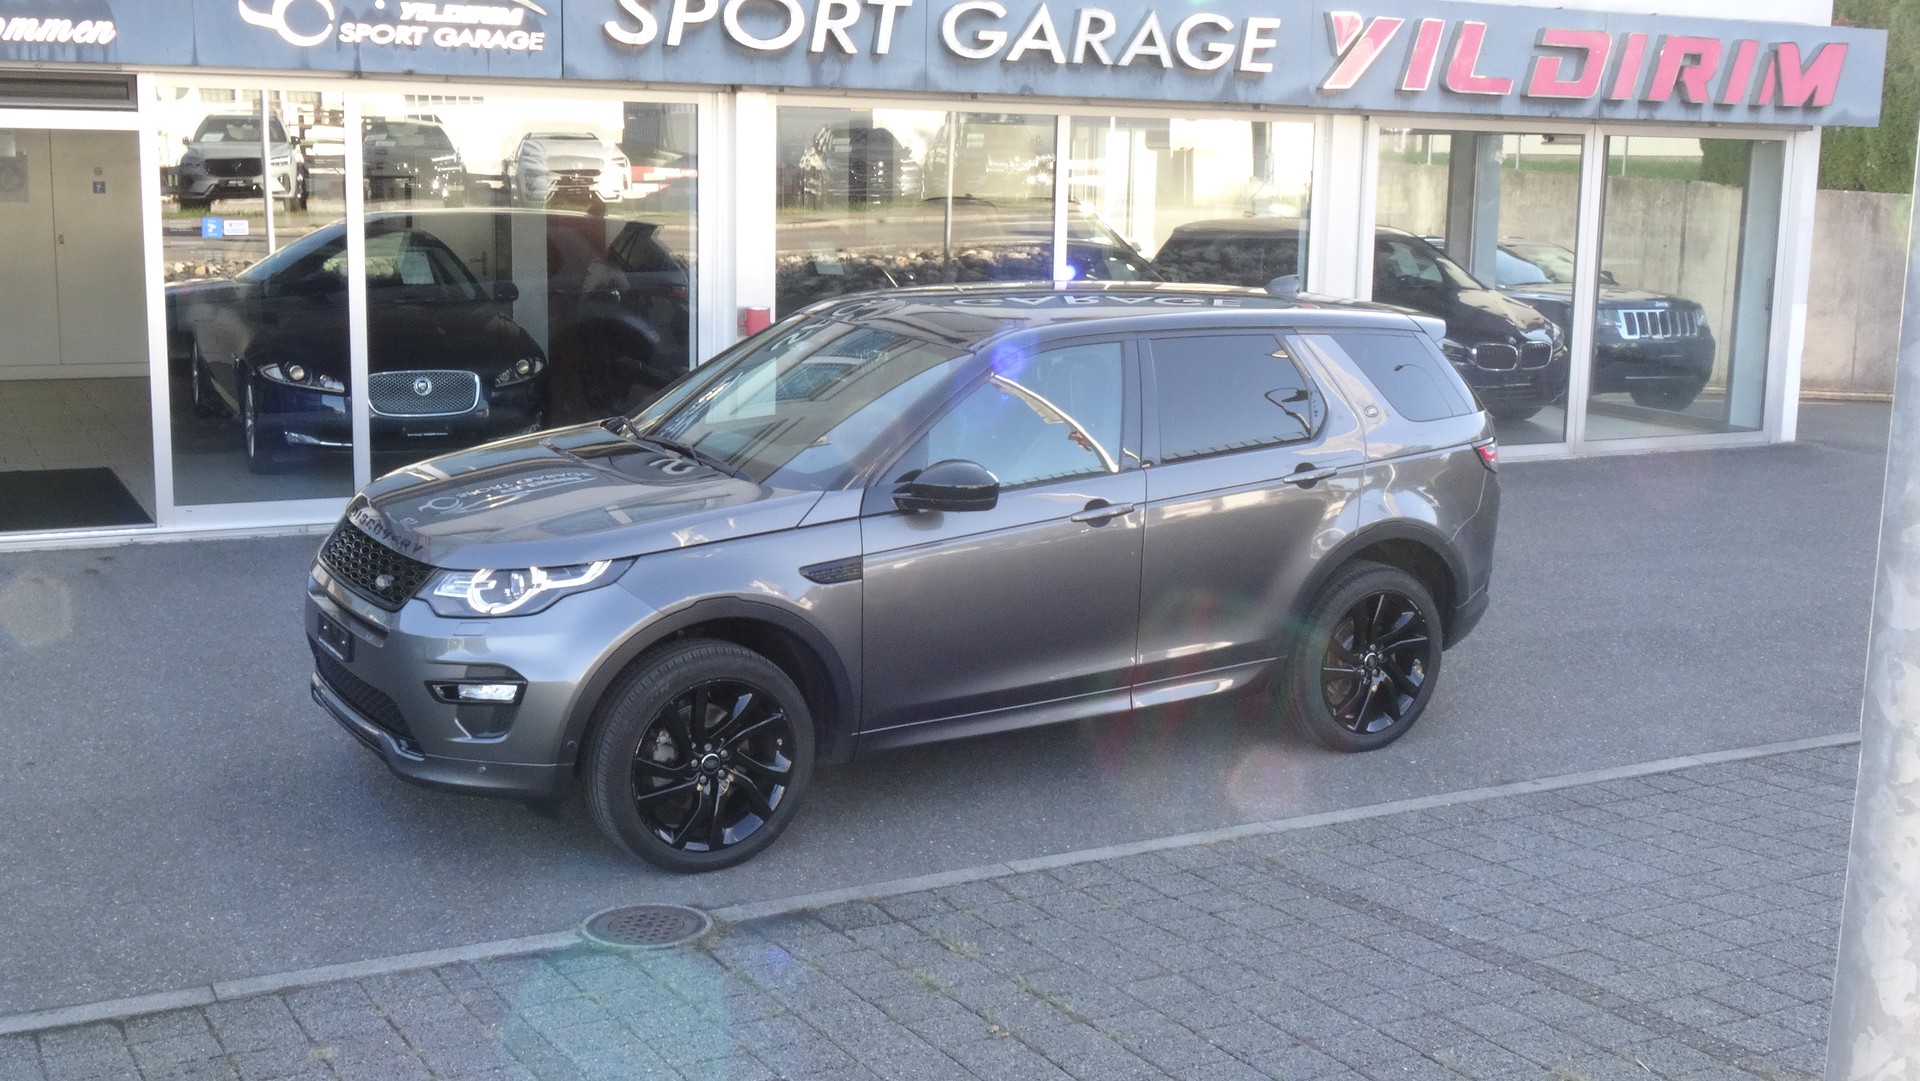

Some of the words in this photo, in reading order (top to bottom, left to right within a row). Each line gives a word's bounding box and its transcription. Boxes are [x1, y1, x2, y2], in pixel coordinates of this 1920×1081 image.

[0, 17, 117, 45] mmen
[338, 23, 428, 46] SPORT
[433, 27, 545, 51] GARAGE
[604, 0, 913, 54] SPORT
[938, 1, 1282, 73] GARAGE
[1320, 10, 1849, 107] YILDIRIM
